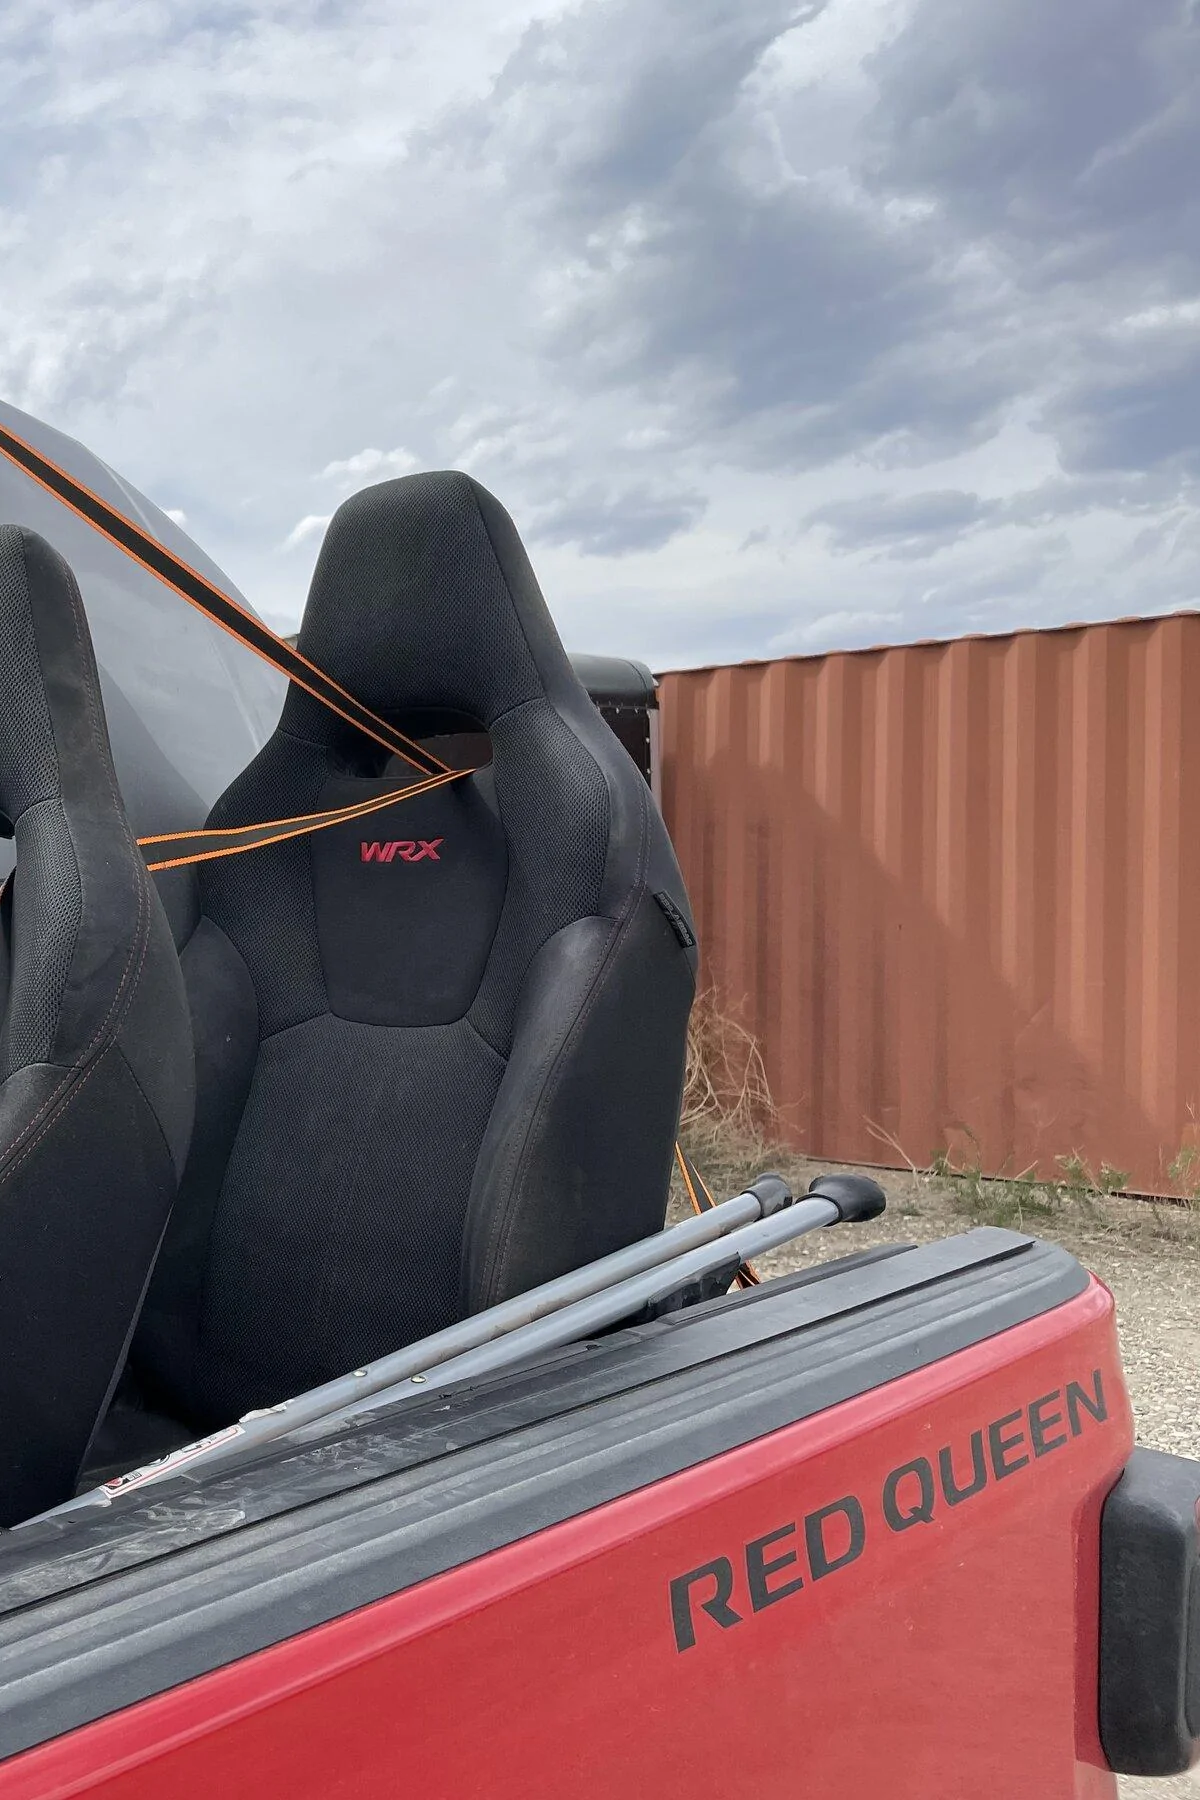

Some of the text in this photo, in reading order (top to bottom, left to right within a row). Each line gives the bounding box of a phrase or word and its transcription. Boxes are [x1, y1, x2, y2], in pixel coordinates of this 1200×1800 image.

[360, 838, 444, 863] WRX
[669, 1368, 1109, 1654] RED QUEEN
